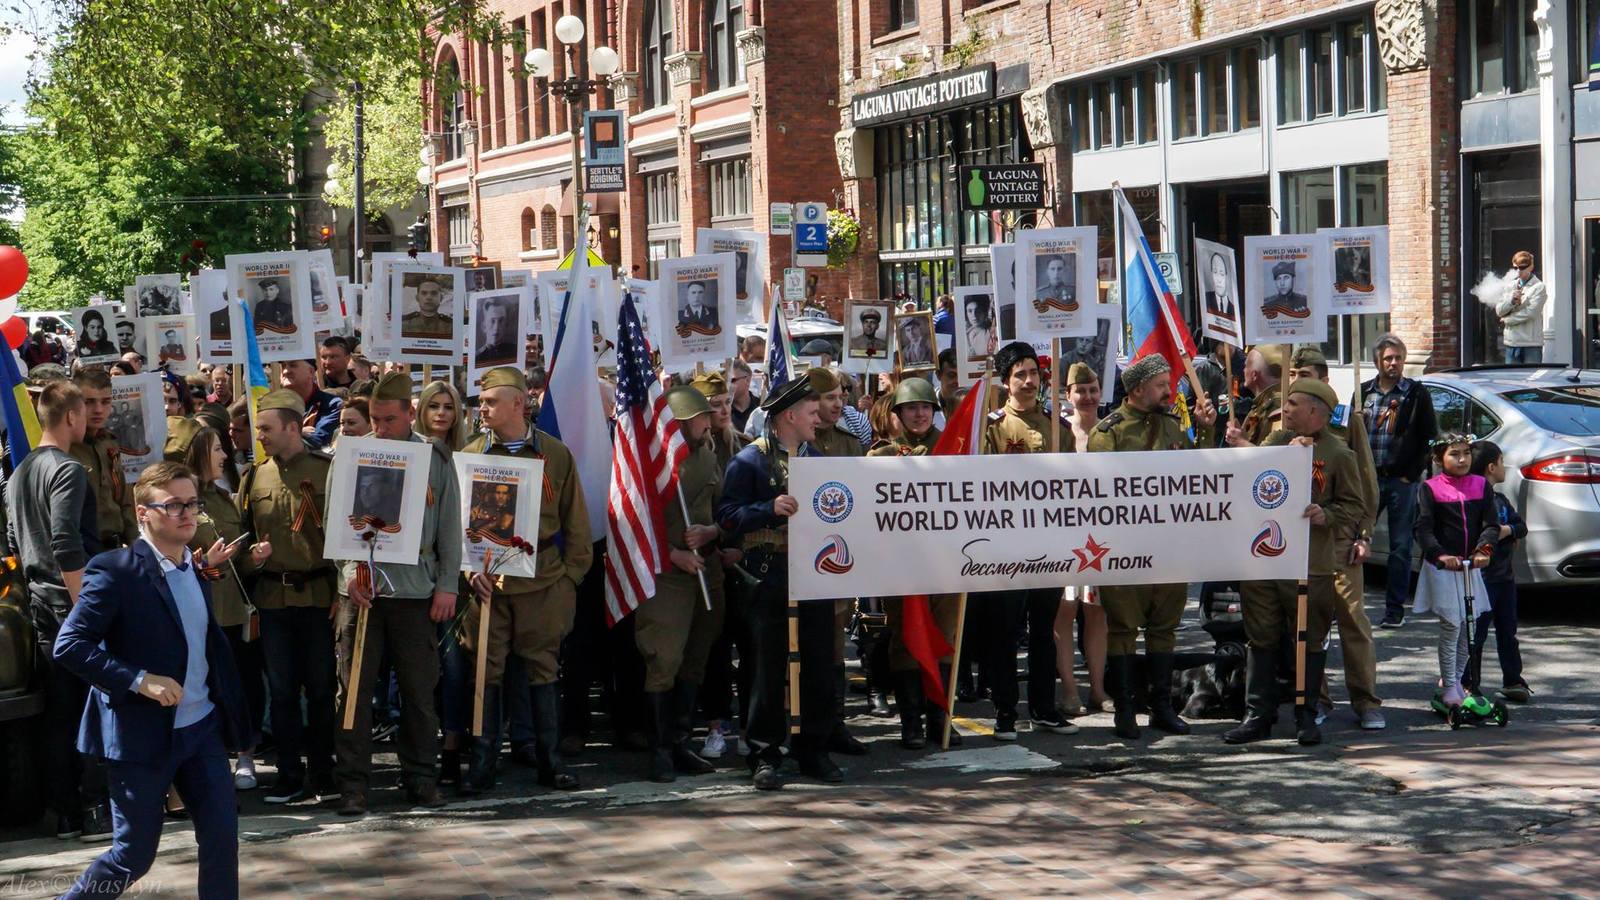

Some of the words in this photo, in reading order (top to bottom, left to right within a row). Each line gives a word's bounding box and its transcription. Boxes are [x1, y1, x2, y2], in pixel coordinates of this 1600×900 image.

[853, 94, 892, 121] LAGUNA
[892, 83, 938, 112] VINTAGE
[939, 70, 988, 102] POTTERY
[590, 174, 623, 183] ORIGINAL
[988, 169, 1038, 180] LAGUNA
[990, 181, 1038, 191] VINTAGE
[990, 194, 1038, 204] POTTERY
[808, 208, 816, 218] P
[806, 226, 816, 240] 2
[1161, 266, 1168, 274] P
[875, 481, 974, 504] SEATTLE
[982, 478, 1108, 502] IMMORTAL
[1114, 474, 1234, 498] REGIMENT
[875, 510, 958, 532] WORLD
[964, 509, 1016, 530] WAR
[1022, 508, 1036, 528] II
[1043, 504, 1166, 528] MEMORIAL
[1170, 502, 1232, 523] WALK
